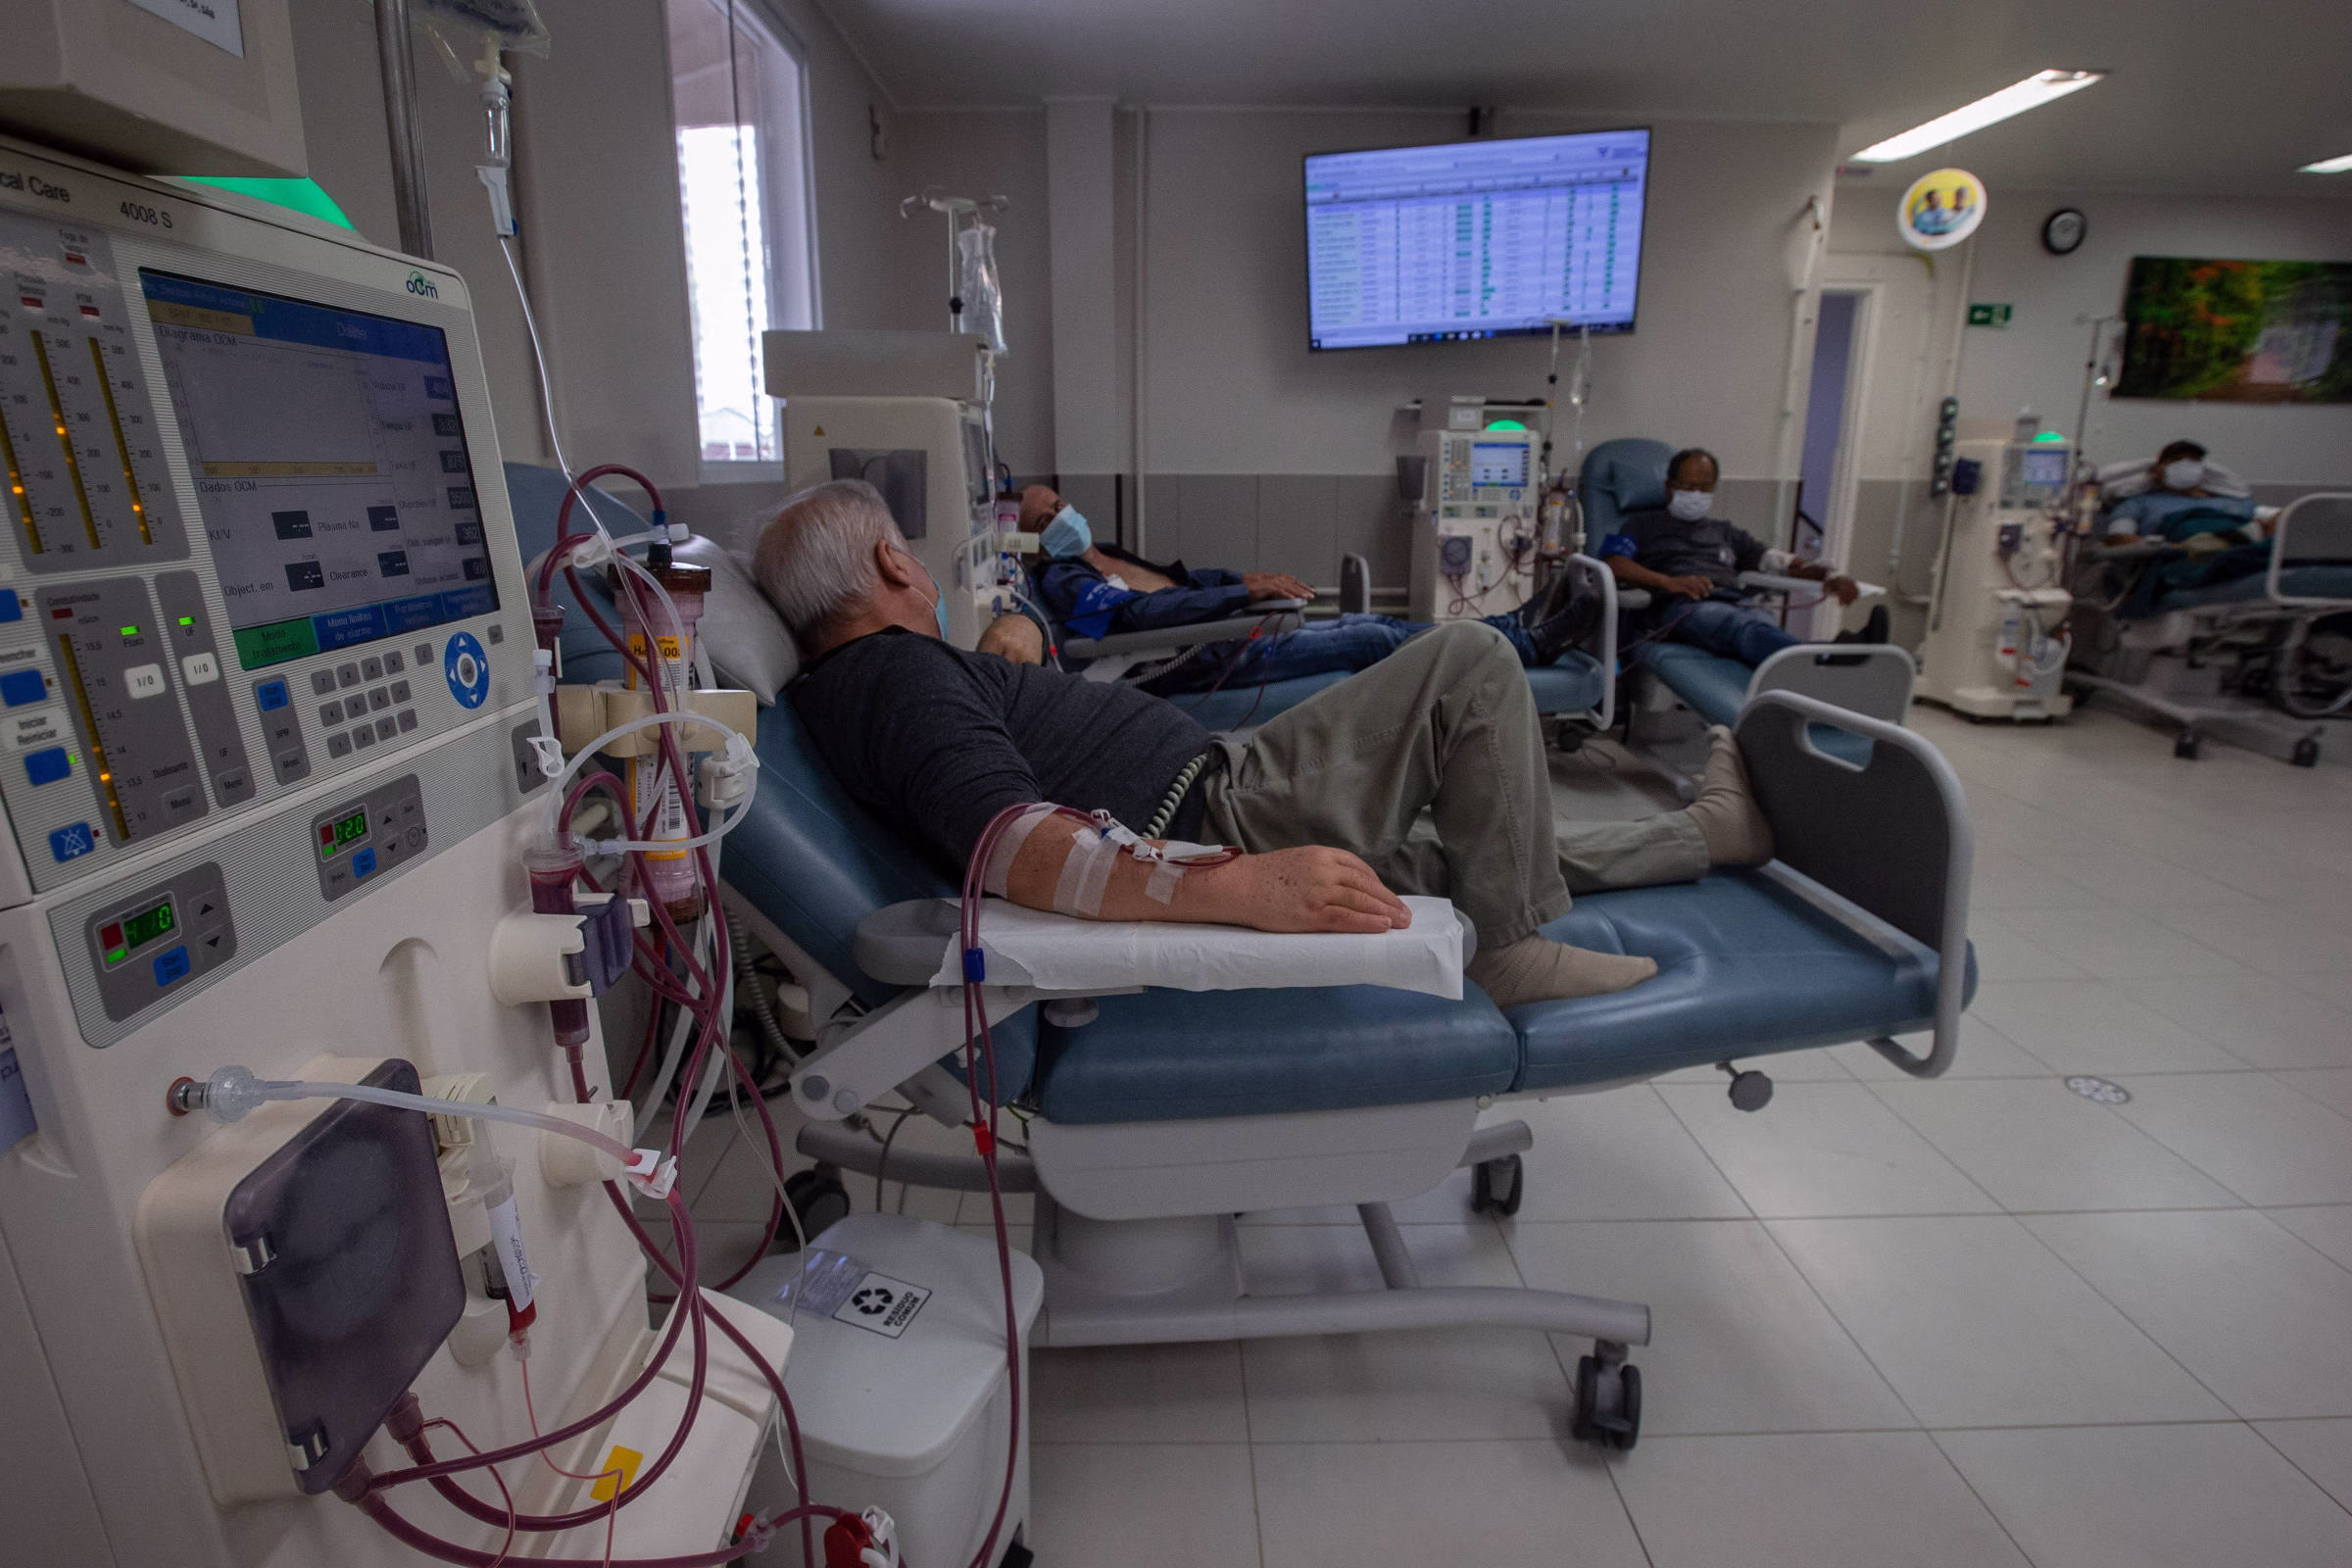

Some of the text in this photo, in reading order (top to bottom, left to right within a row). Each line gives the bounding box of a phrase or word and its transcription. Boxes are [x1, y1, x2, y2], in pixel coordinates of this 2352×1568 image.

[28, 175, 71, 203] Care
[120, 201, 172, 228] 4008 S
[159, 325, 238, 346] Diagrama OCM
[199, 480, 258, 493] Dados OCM
[209, 529, 230, 540] Kt/V
[318, 521, 346, 532] Plasma
[329, 567, 368, 581] Clearance
[122, 638, 144, 648] Fluxo
[884, 1292, 913, 1326] RESÍDUO
[894, 1297, 921, 1327] COMUM
